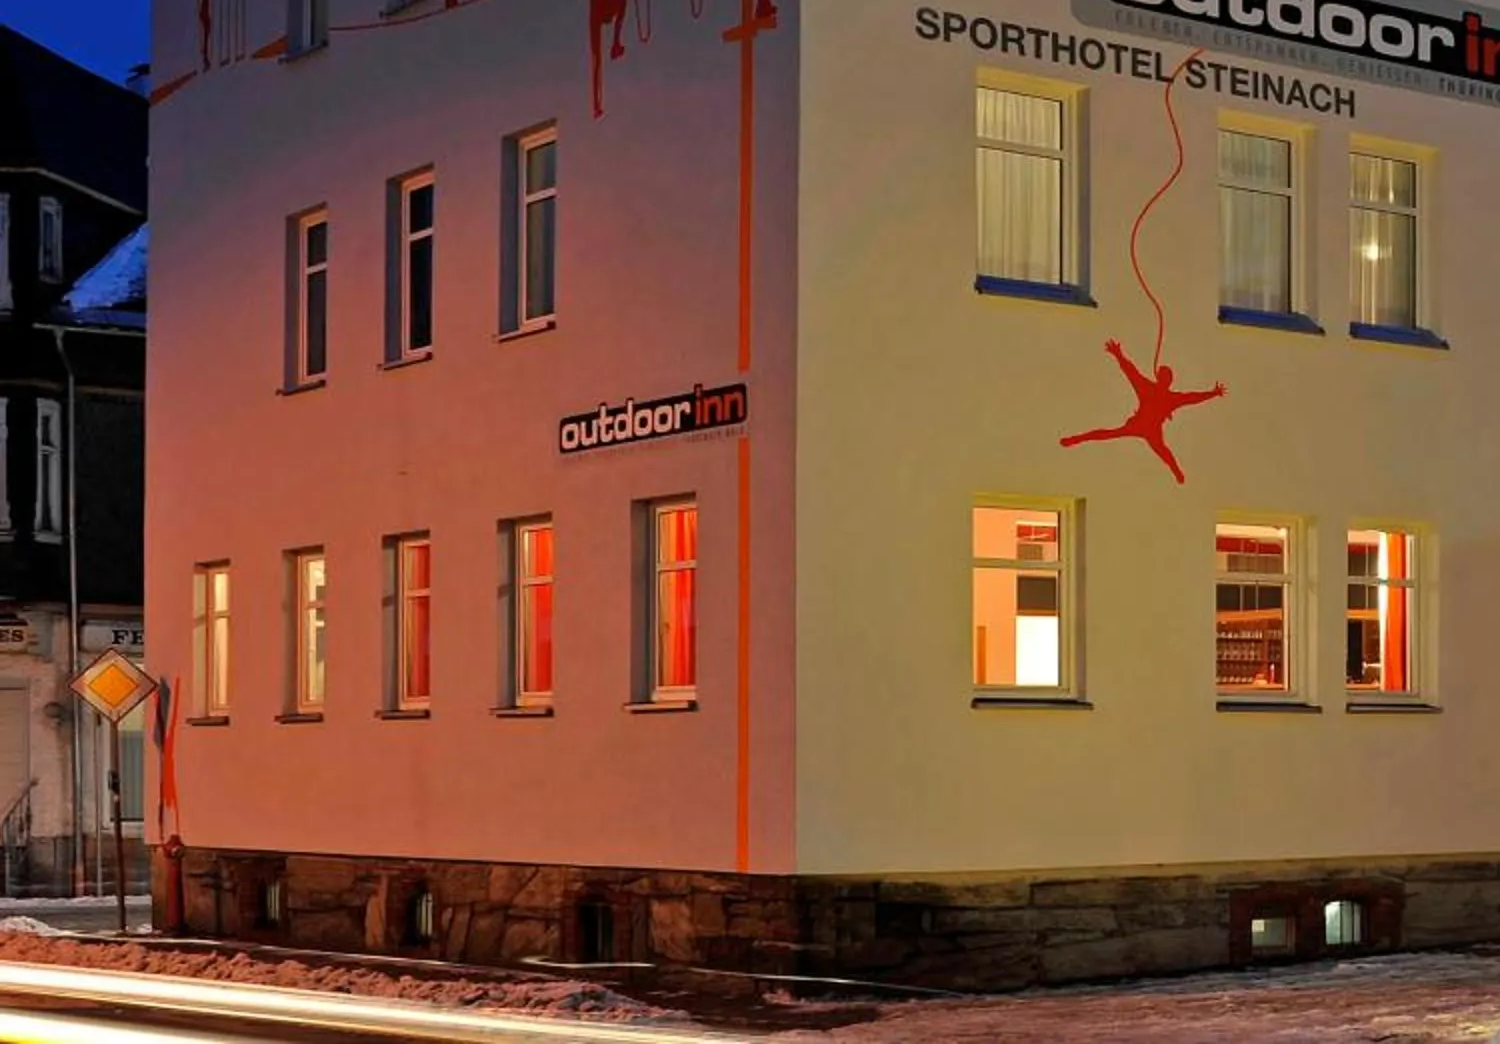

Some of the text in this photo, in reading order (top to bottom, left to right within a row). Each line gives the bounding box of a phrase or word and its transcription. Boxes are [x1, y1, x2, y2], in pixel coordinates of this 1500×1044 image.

[915, 7, 1356, 118] SPORTHOTEL STEINACH
[561, 400, 691, 450] outdoor
[694, 386, 745, 427] inn
